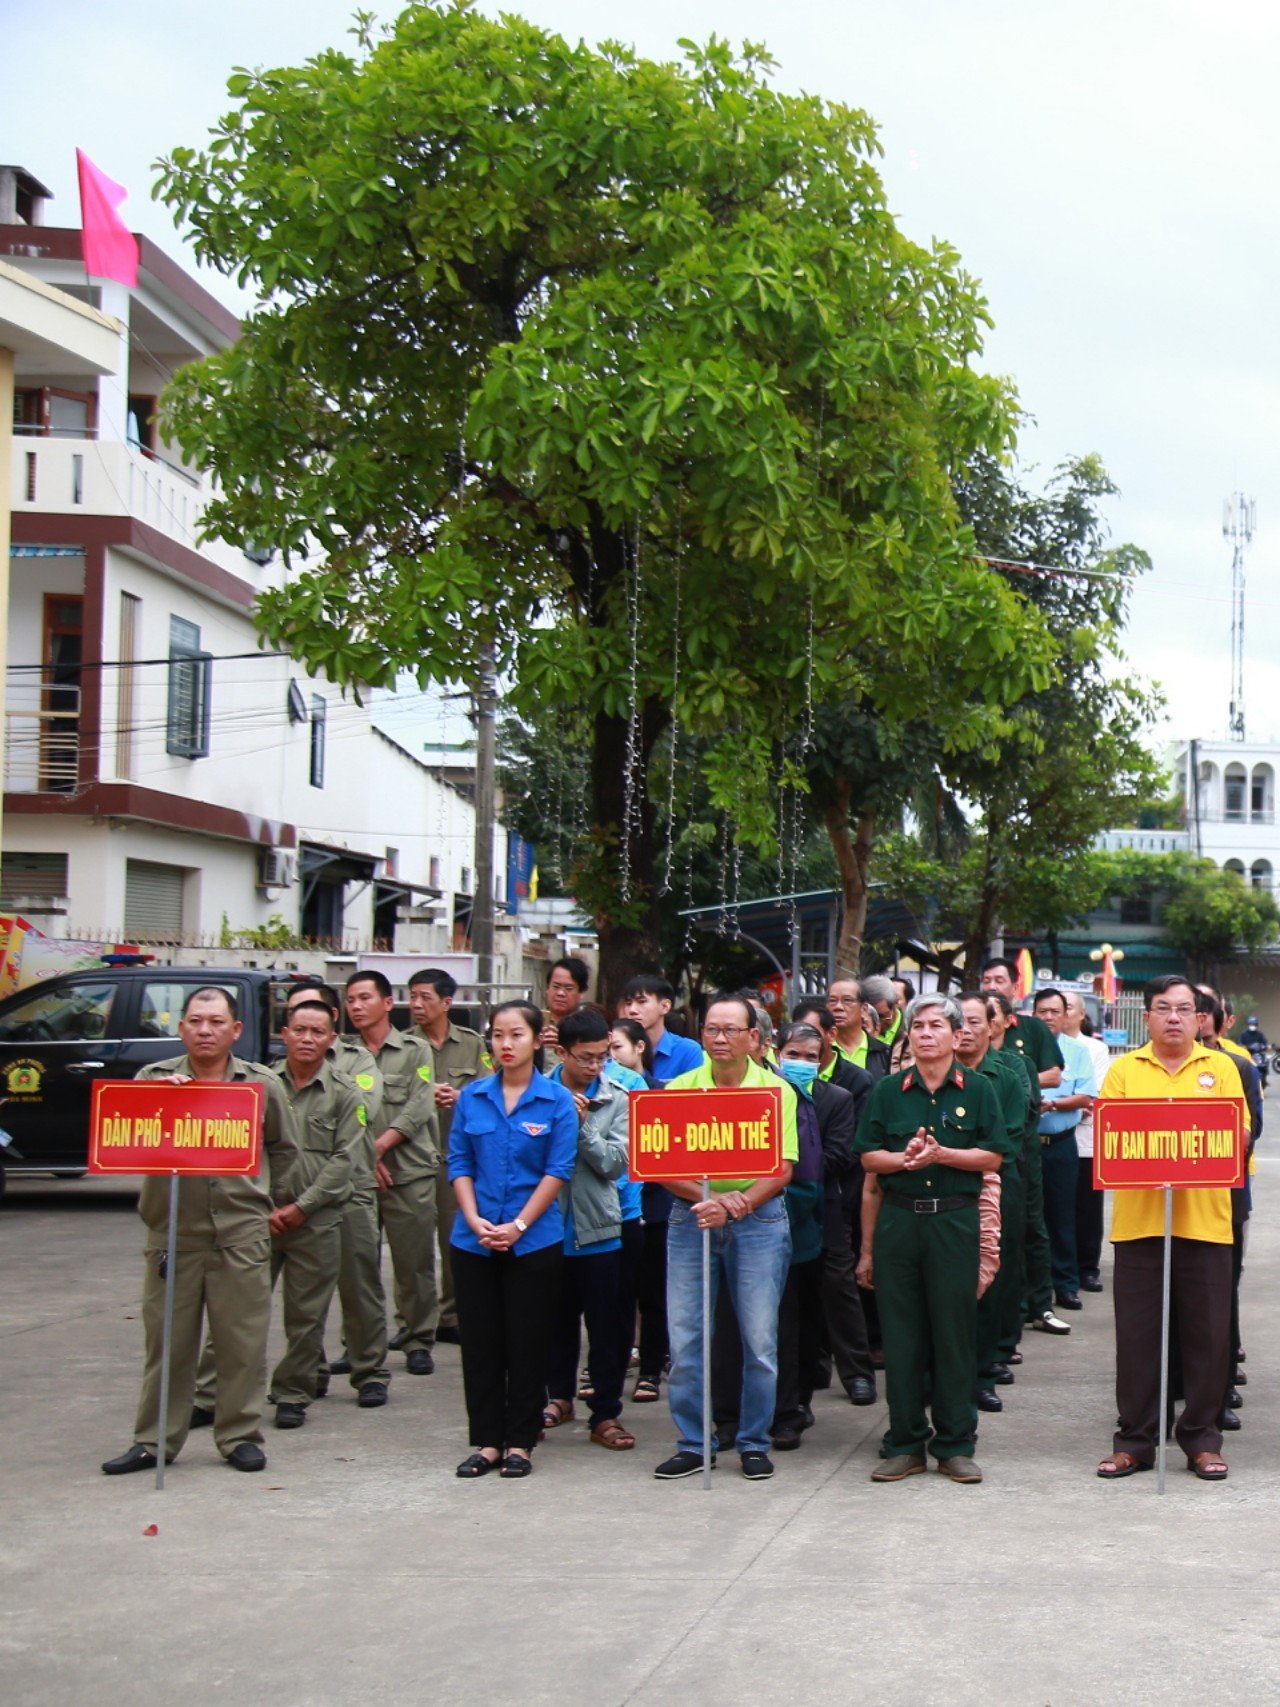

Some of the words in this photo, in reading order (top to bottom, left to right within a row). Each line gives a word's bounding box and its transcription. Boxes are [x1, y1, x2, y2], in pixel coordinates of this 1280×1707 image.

[102, 1111, 131, 1147] DÂN
[134, 1107, 163, 1148] PHỐ
[173, 1112, 202, 1148] DÂN
[204, 1112, 250, 1149] PHÒNG
[640, 1117, 669, 1159] HỘI
[685, 1116, 734, 1151] ĐOÀN
[738, 1108, 771, 1150] THỂ
[1104, 1121, 1119, 1160] ỦY
[1121, 1130, 1146, 1160] BAN
[1147, 1130, 1179, 1162] MTTQ
[1180, 1123, 1205, 1165] VIỆT
[1206, 1129, 1234, 1159] NAM
